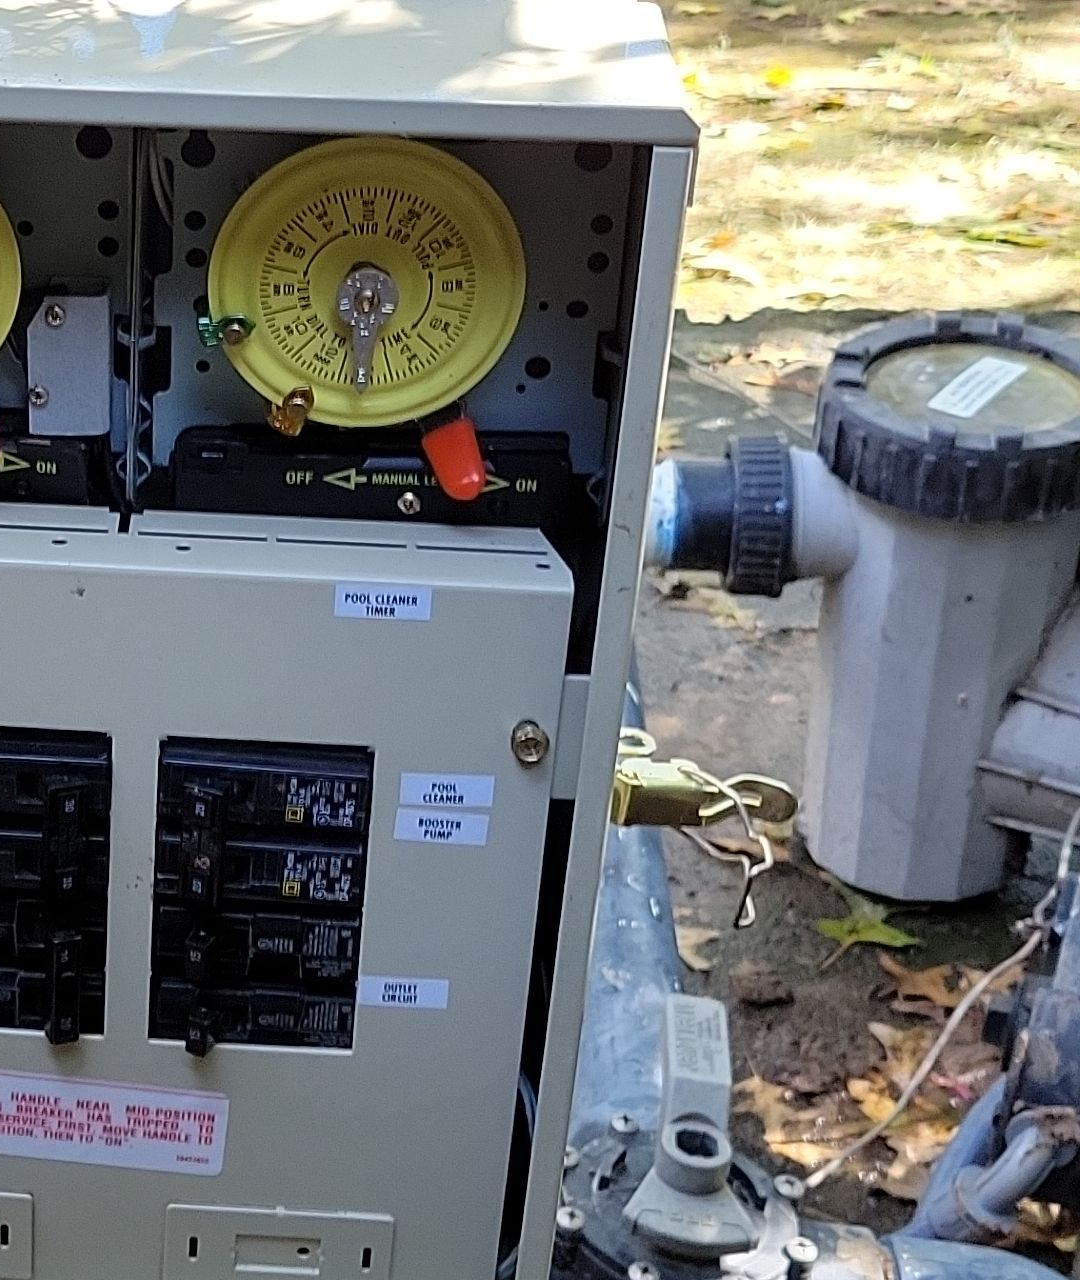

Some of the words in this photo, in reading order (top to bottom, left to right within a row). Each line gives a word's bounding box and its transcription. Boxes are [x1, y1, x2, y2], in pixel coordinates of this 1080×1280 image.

[380, 329, 412, 349] TIME
[37, 461, 57, 475] ON
[286, 471, 313, 485] OFF
[372, 472, 420, 486] MANUAL
[516, 479, 537, 493] ON
[345, 592, 371, 605] POOL
[375, 594, 418, 607] CLEANER
[366, 605, 396, 617] TIMER
[431, 782, 457, 794] POOL
[422, 794, 464, 805] CLEANER
[418, 818, 461, 831] BOOSTER
[423, 829, 452, 840] PUMP
[383, 983, 417, 994] OUTLET
[11, 1091, 61, 1106] HANDLE
[76, 1098, 110, 1111] NEAR
[125, 1104, 215, 1123] MID-POSITION
[17, 1104, 73, 1119] BREAKER
[87, 1111, 111, 1123] HAS
[199, 1124, 214, 1135] TO
[44, 1130, 74, 1142] THEN
[79, 1133, 94, 1144] TO
[102, 1125, 138, 1138] MOVE
[142, 1129, 192, 1143] HANDLE
[198, 1135, 213, 1146] TO
